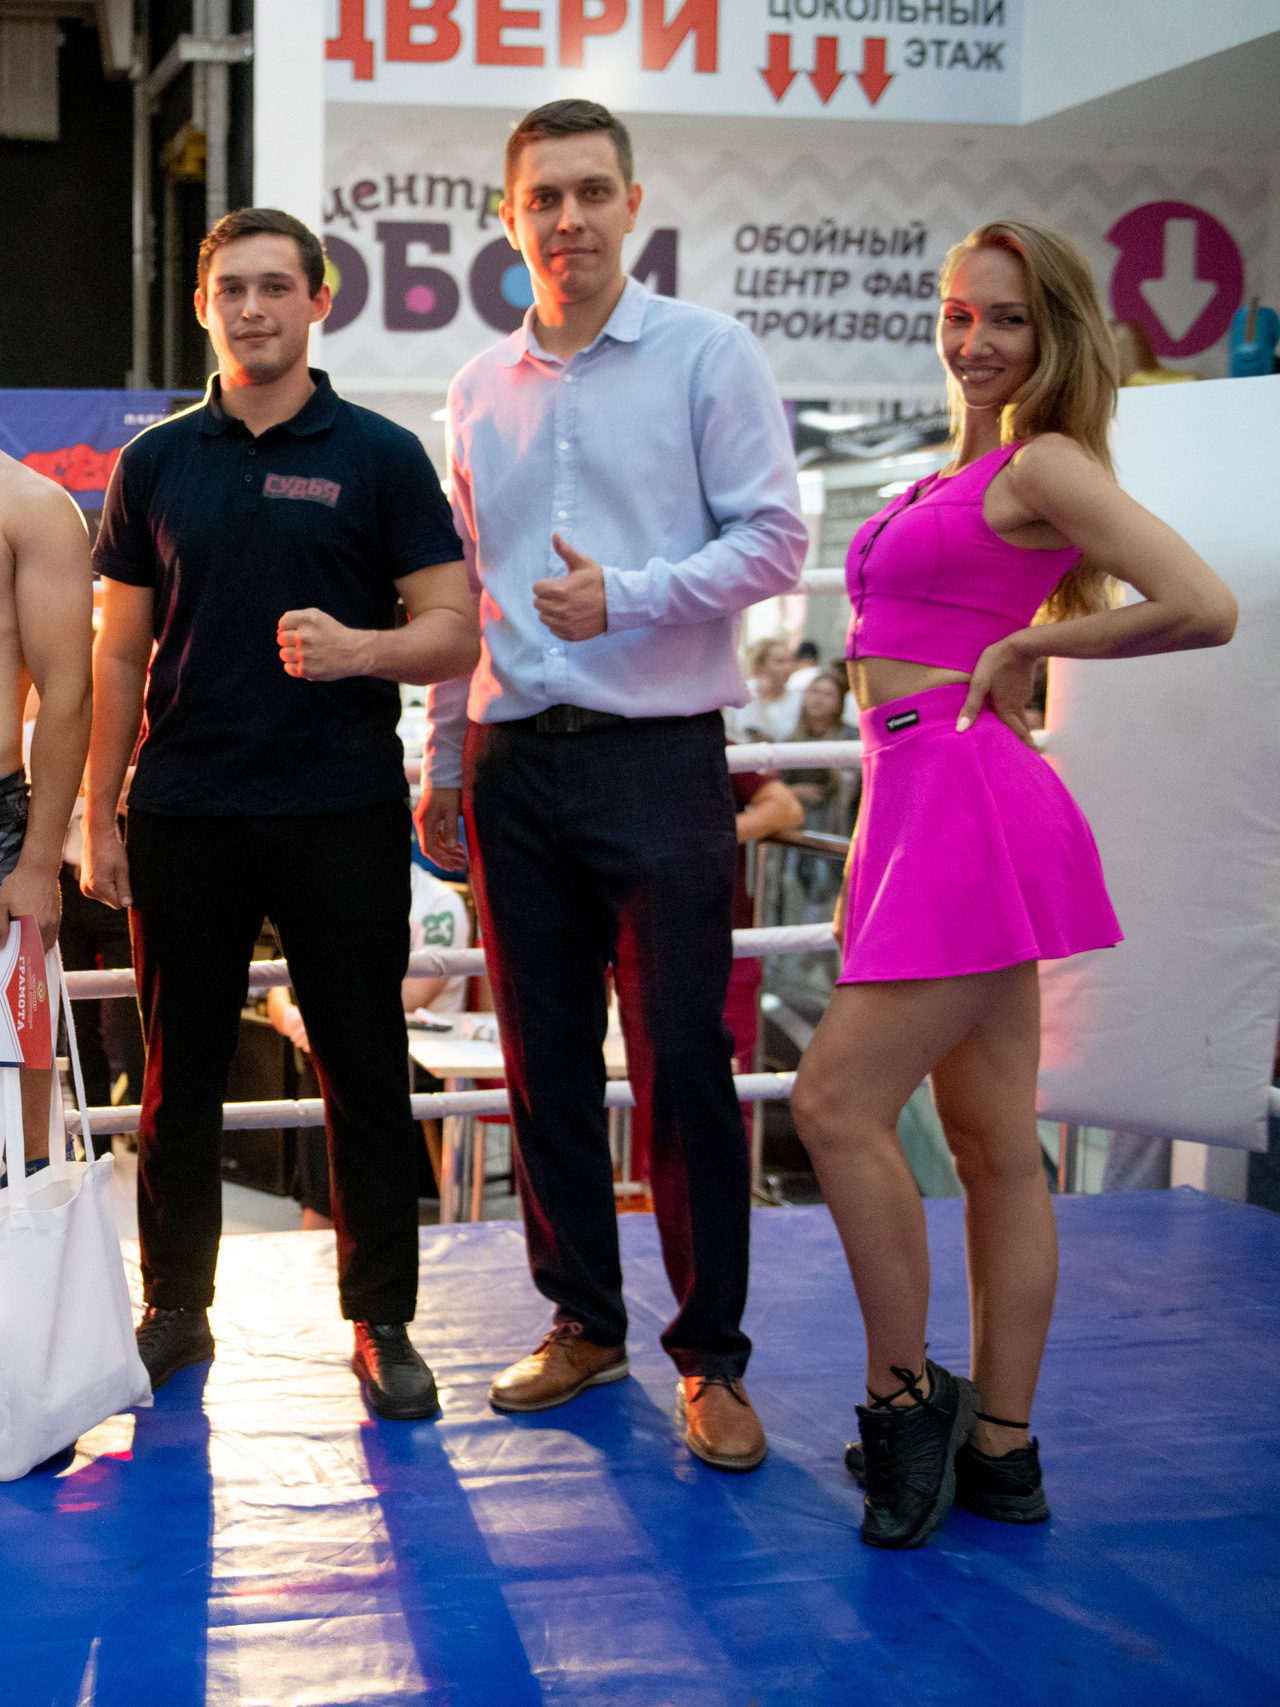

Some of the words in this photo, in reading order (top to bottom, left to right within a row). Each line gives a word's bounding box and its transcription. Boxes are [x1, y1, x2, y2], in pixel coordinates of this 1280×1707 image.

[324, 0, 719, 81] ДВЕРИ
[904, 38, 1006, 71] ЭТАЖ
[323, 172, 508, 230] центр
[735, 218, 927, 255] ОБОЙНЫЙ
[734, 268, 850, 299] ЦЕНТР
[863, 271, 940, 299] ФАБ
[735, 308, 934, 344] ПРОИЗВОД
[265, 475, 340, 505] СУДЬЯ
[17, 955, 26, 1031] ГРАМОТА
